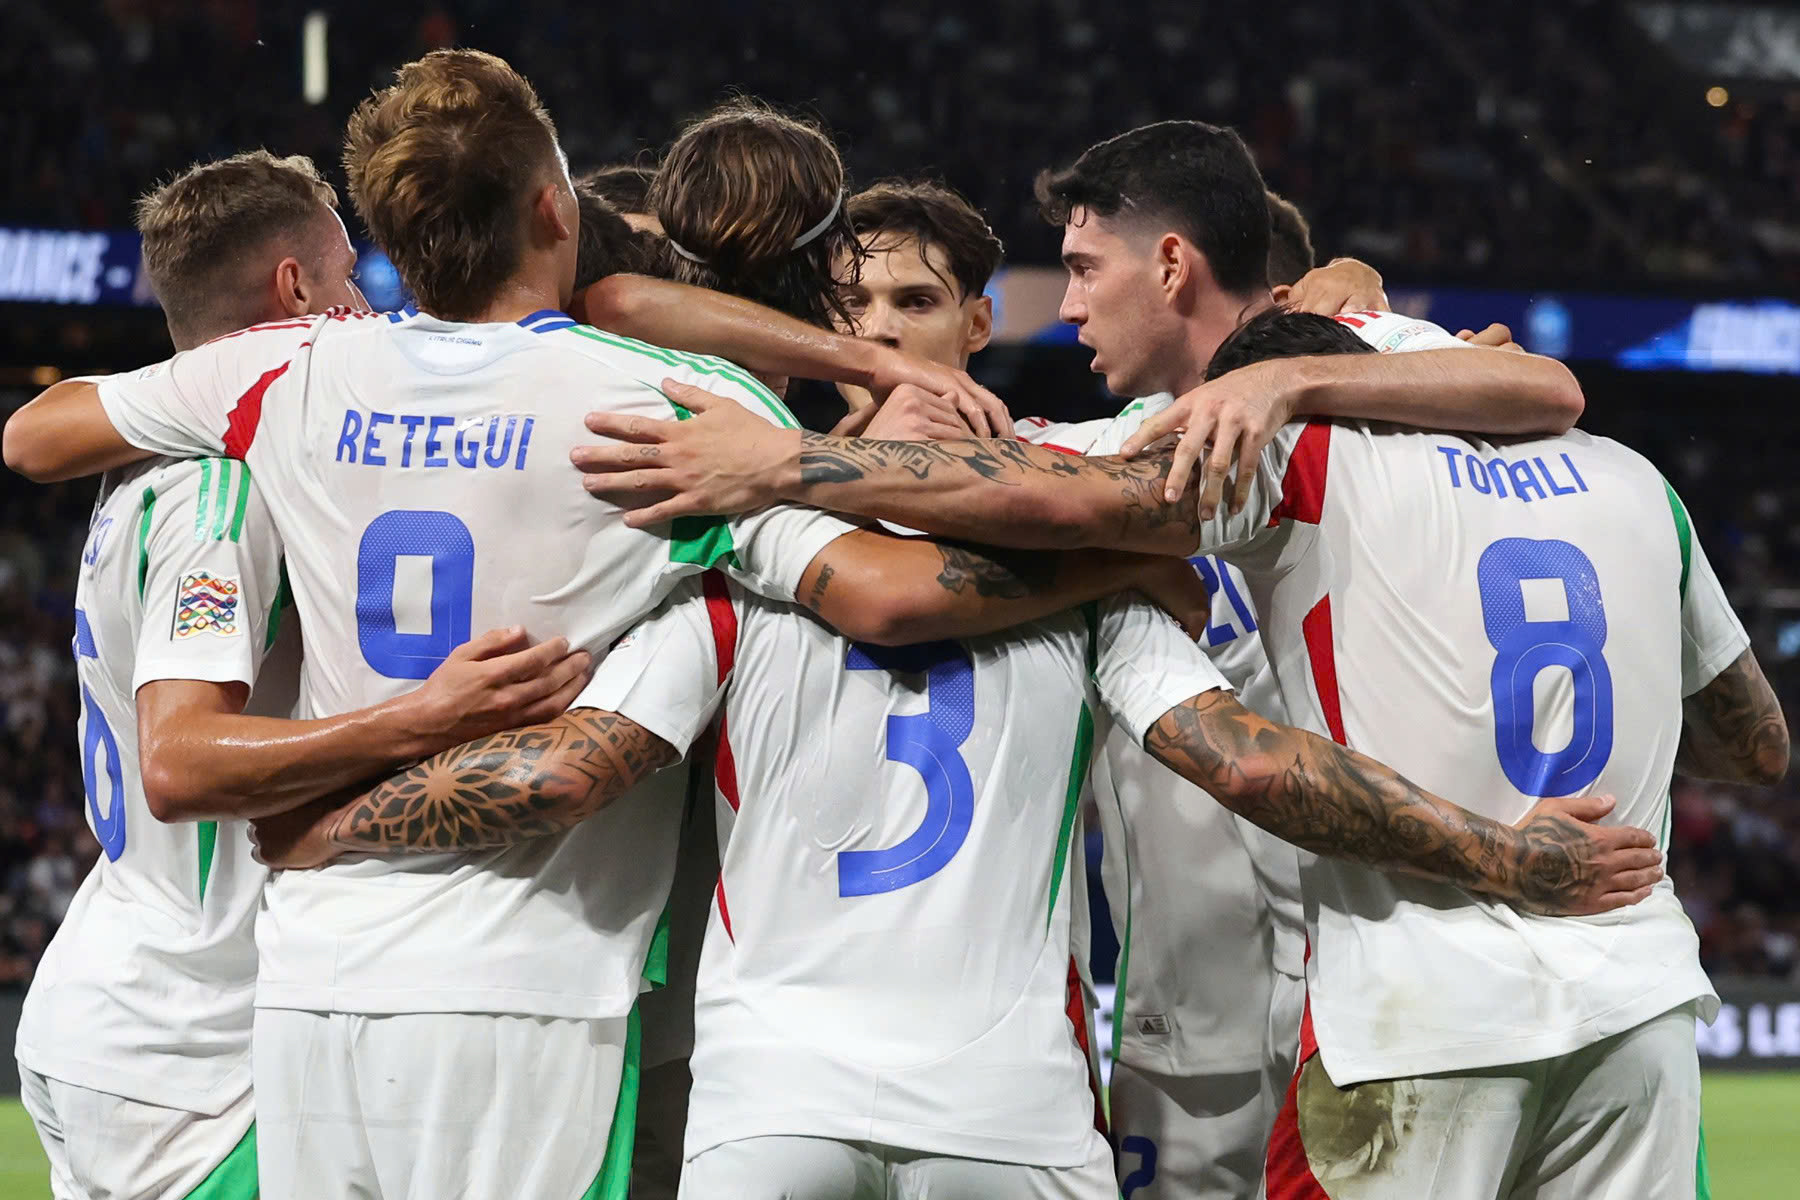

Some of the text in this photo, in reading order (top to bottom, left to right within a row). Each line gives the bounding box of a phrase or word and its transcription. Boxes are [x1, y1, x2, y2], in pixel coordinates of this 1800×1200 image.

[336, 409, 535, 471] RETEGUI
[1437, 446, 1589, 503] TONALI
[1477, 537, 1614, 798] 8
[837, 640, 975, 898] 3
